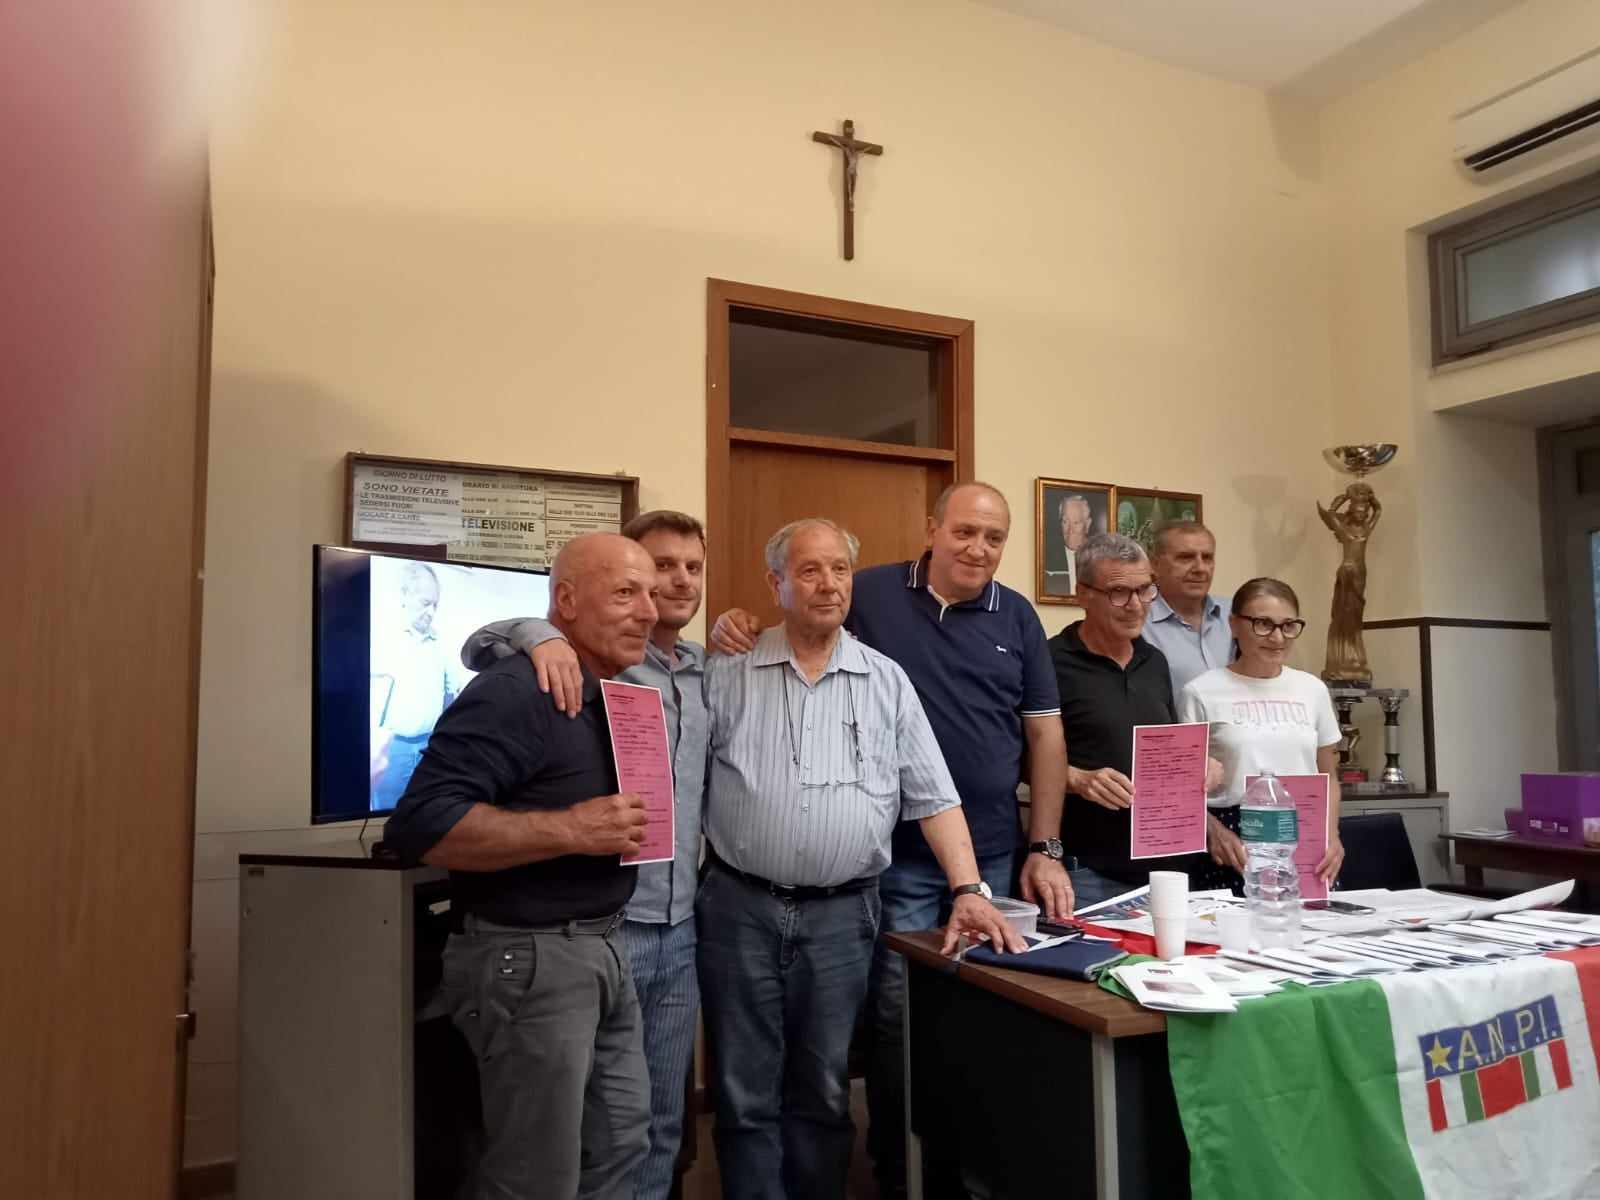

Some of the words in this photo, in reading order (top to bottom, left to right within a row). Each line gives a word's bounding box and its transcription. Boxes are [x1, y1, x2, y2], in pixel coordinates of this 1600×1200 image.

[420, 472, 447, 482] LUTTO
[362, 482, 399, 492] SONO
[402, 486, 449, 497] VIETATE
[462, 518, 535, 532] TELEVISIONE
[1458, 1003, 1558, 1070] A.N.P.I.
